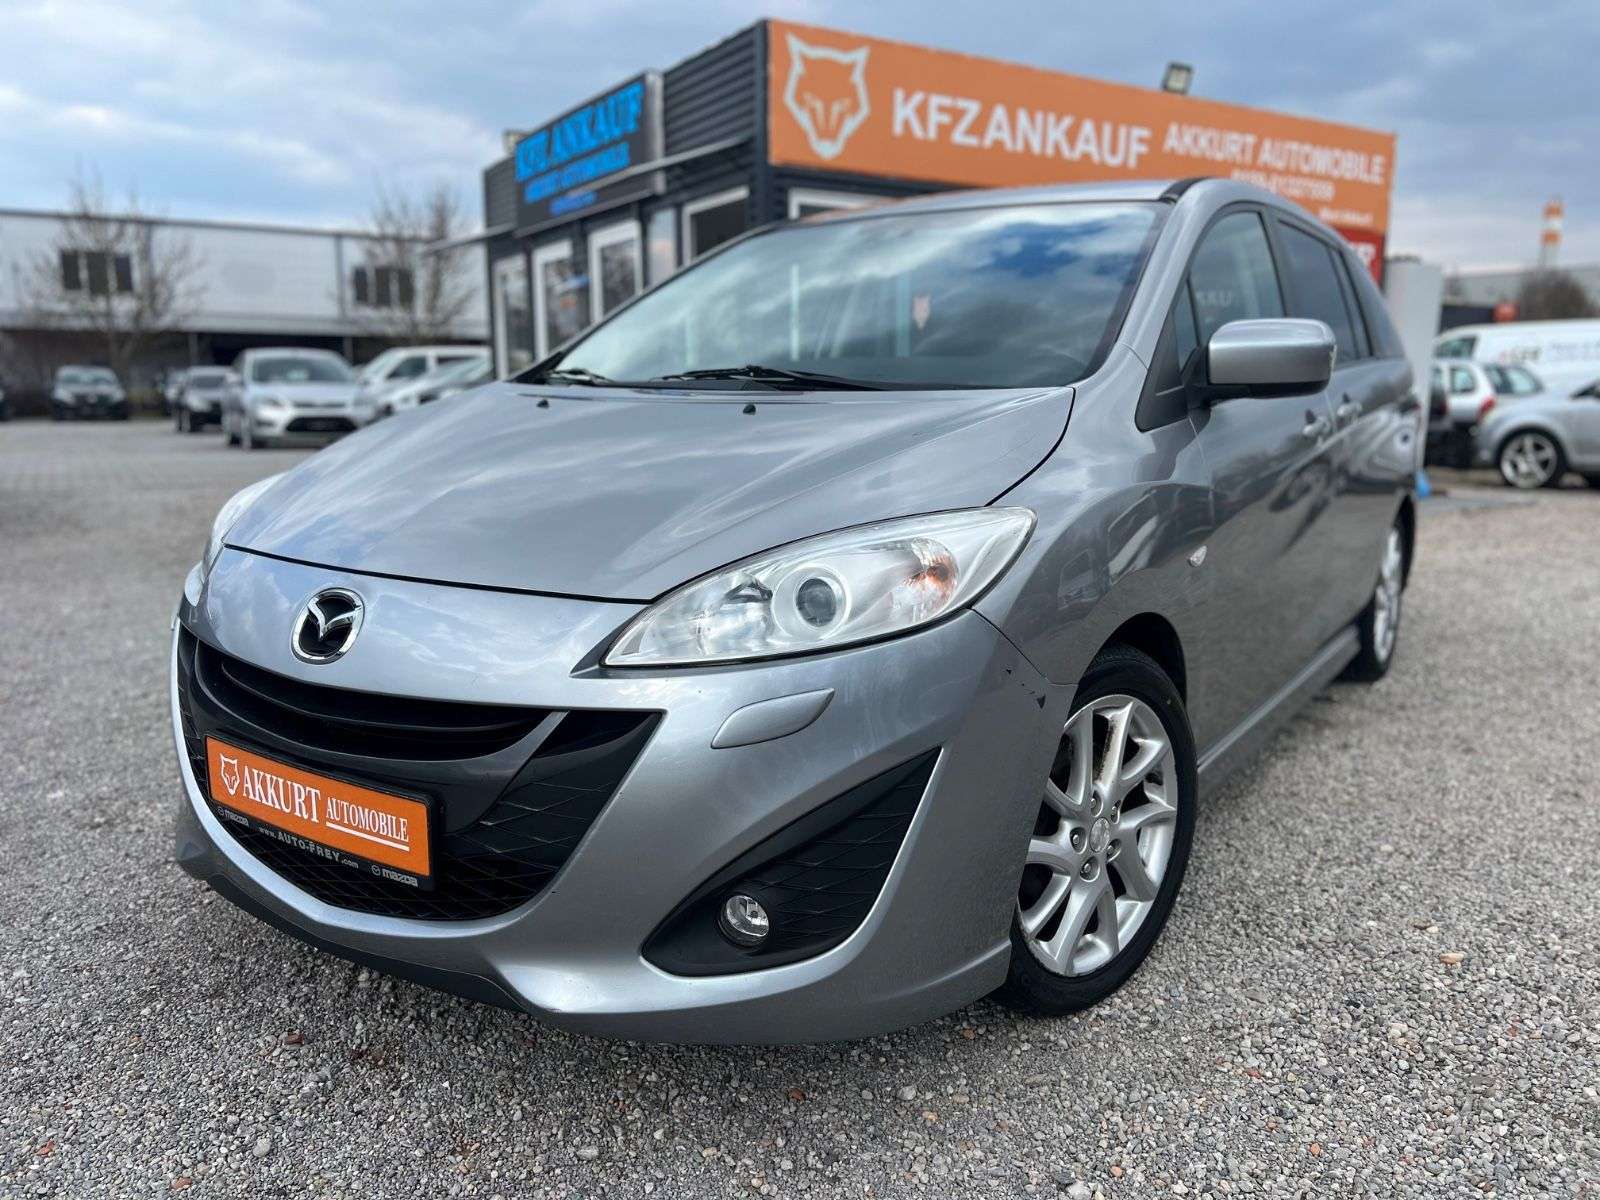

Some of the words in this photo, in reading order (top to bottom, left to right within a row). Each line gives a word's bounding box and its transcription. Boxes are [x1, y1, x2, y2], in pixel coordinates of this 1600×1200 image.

[892, 87, 1152, 169] KFZANKAUF
[1163, 122, 1257, 166] AKKURT
[1257, 137, 1386, 185] AUTOMOBILE
[242, 765, 321, 823] AKKURT
[325, 797, 410, 843] AUTOMOBILE
[382, 868, 419, 888] mazda
